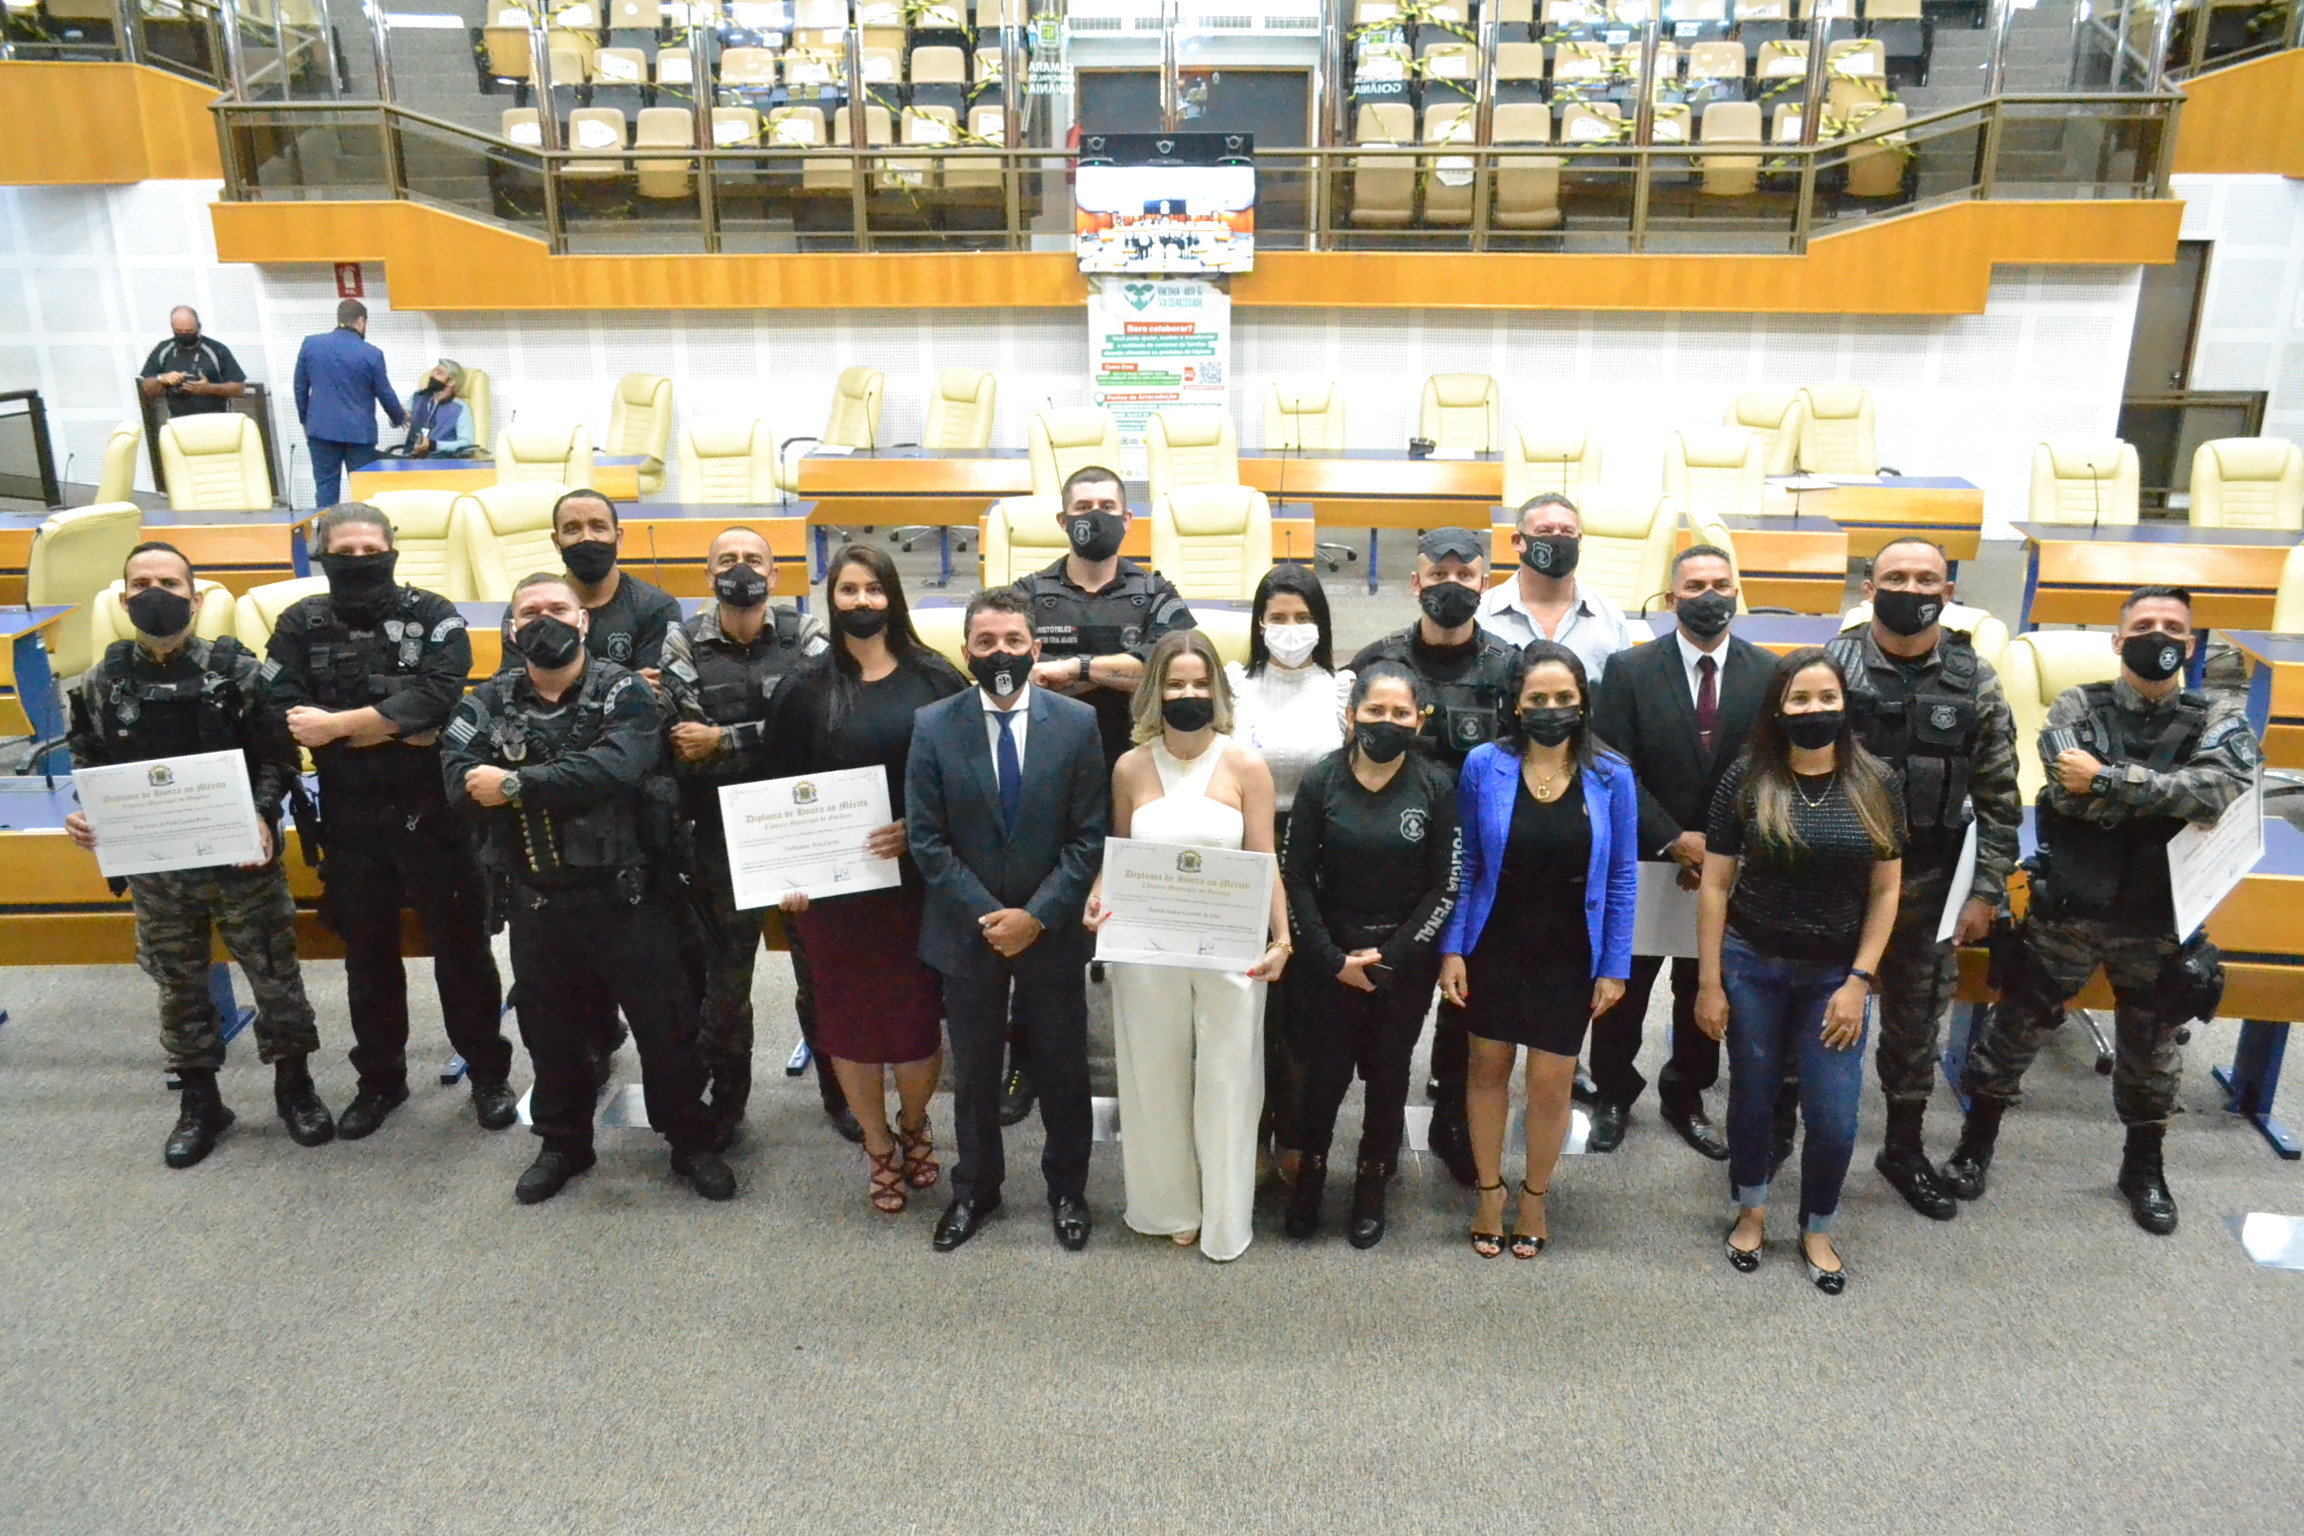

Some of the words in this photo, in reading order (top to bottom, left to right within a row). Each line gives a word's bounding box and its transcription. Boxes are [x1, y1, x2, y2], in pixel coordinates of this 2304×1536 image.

[1126, 325, 1148, 333] Bora
[1149, 324, 1193, 333] colaborar?
[745, 813, 783, 824] Diploma
[784, 810, 795, 818] de
[826, 803, 837, 812] ao
[838, 799, 869, 811] Mérito
[1413, 897, 1455, 942] PENAL
